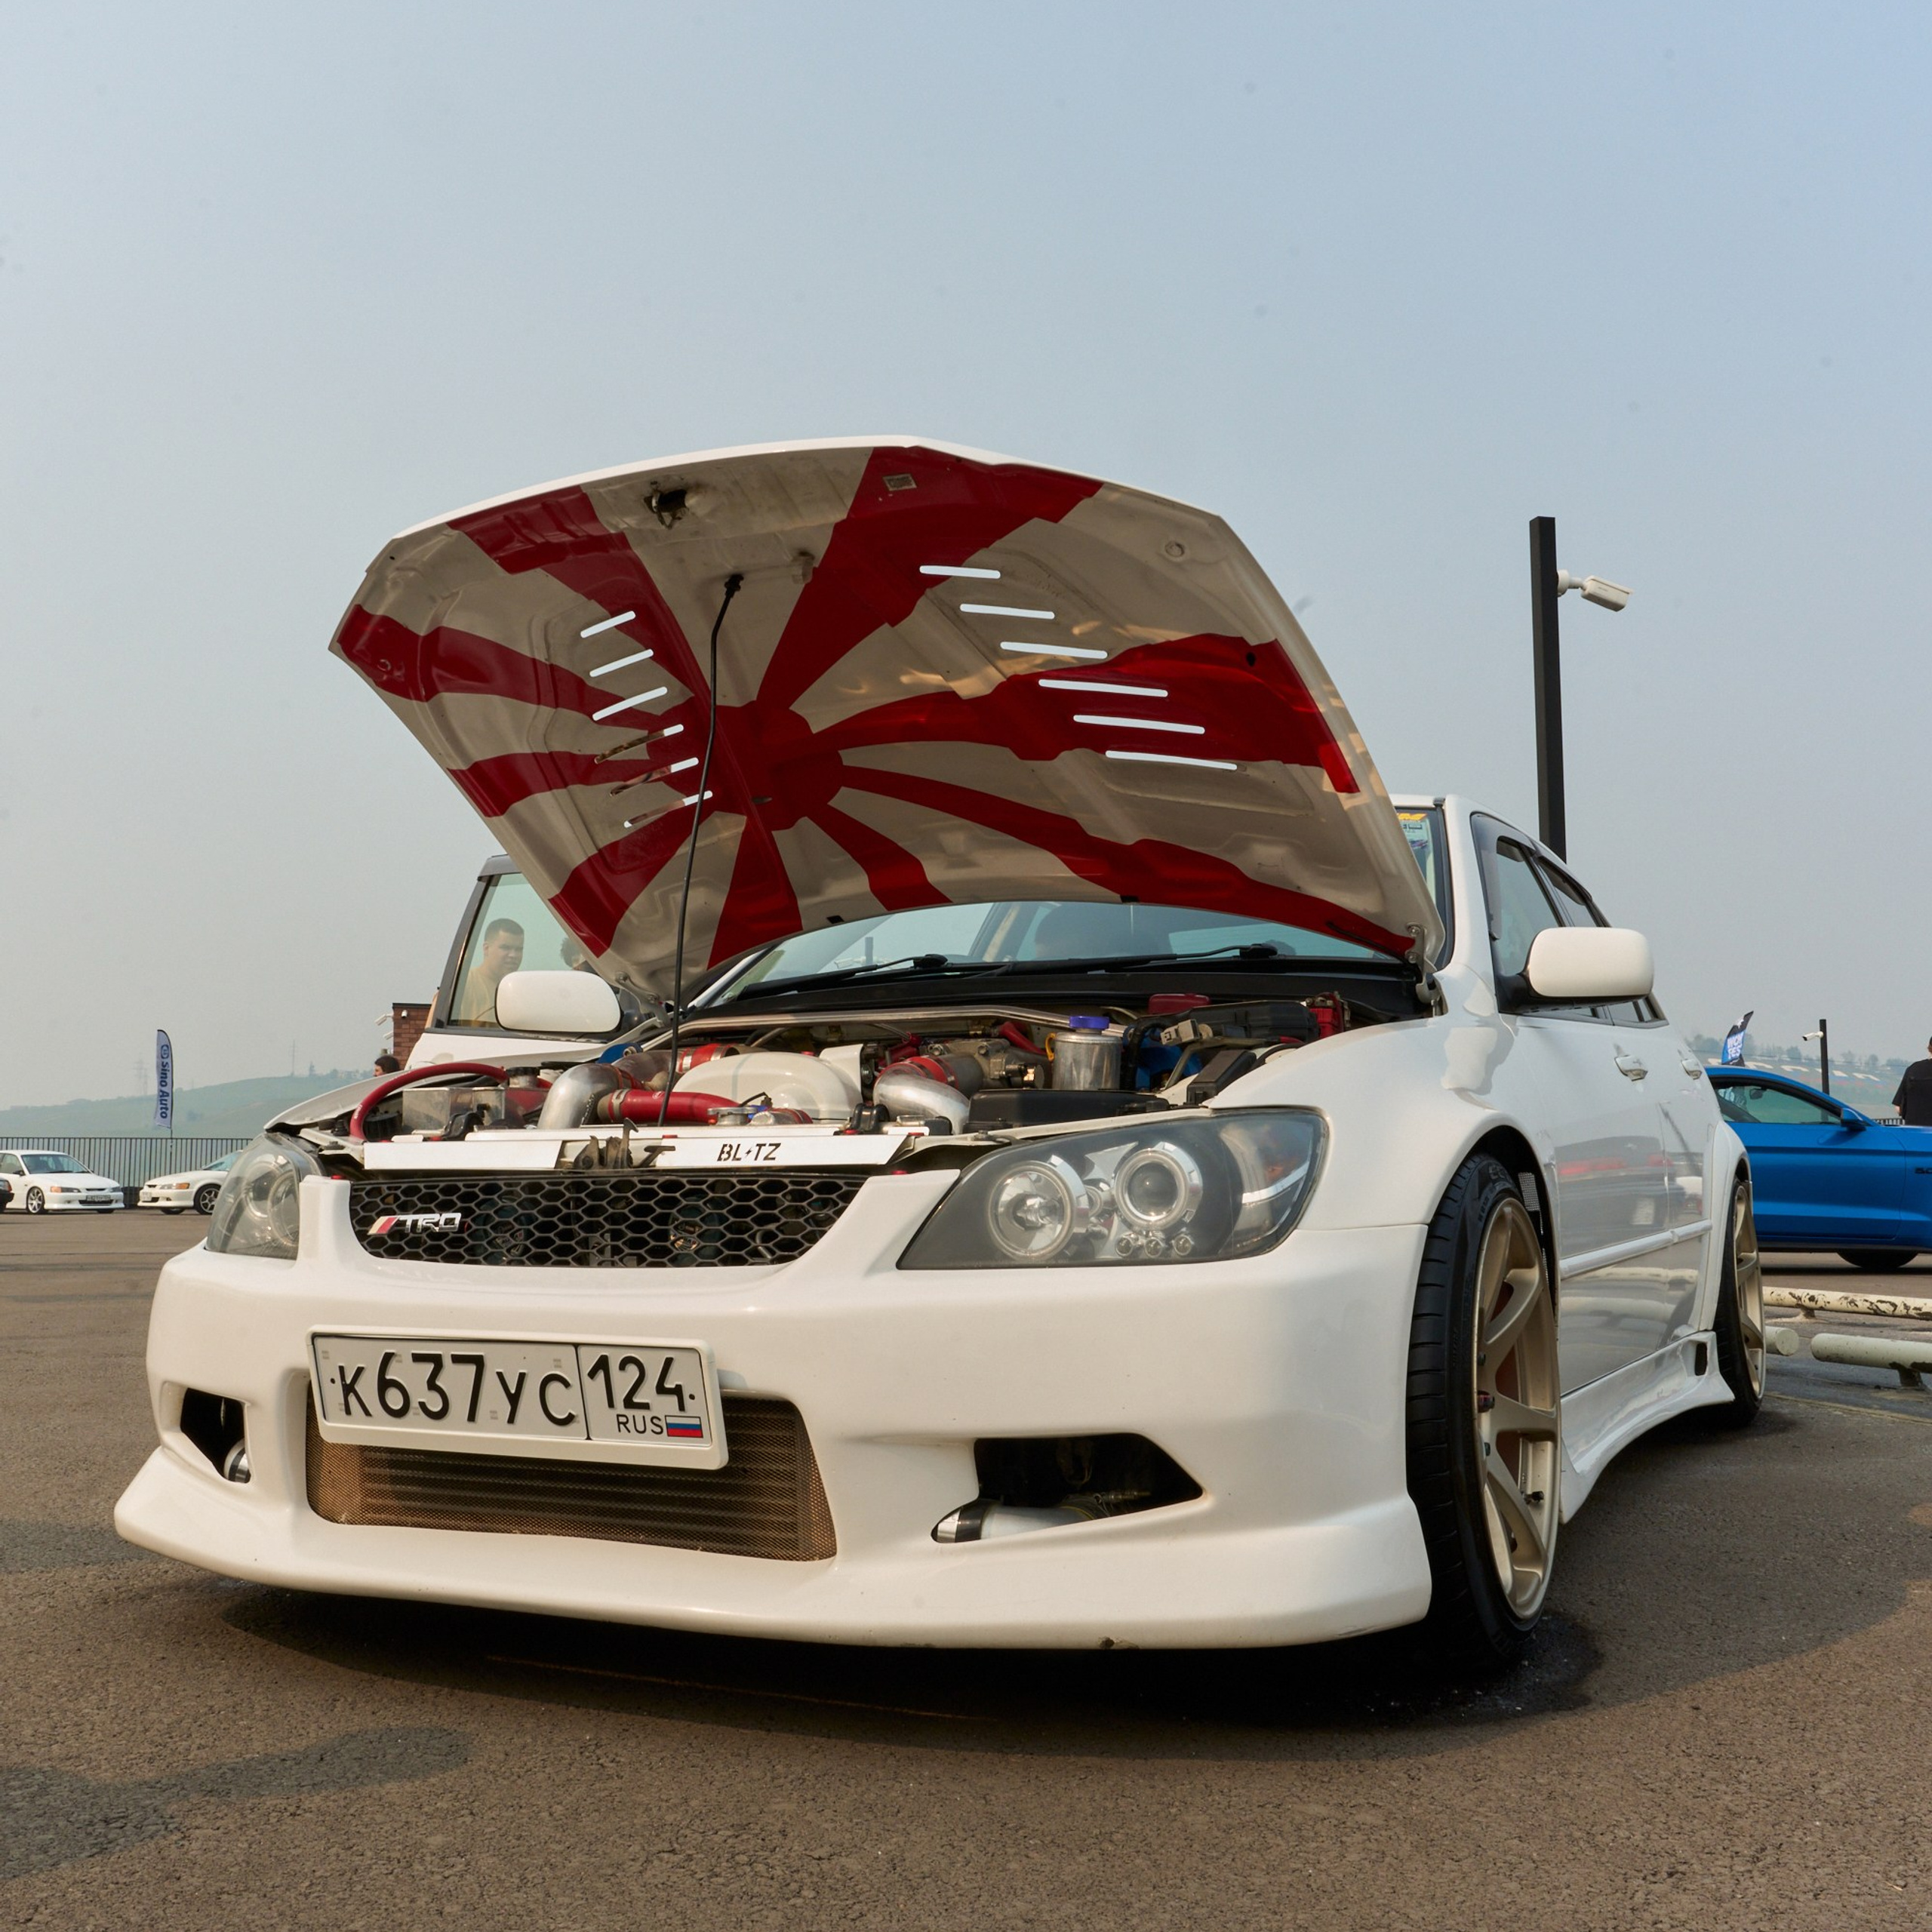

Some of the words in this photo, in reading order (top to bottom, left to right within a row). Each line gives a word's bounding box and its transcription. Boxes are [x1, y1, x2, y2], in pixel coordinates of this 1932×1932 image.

[159, 1090, 170, 1118] Auto
[398, 1213, 461, 1232] TRD
[587, 1354, 686, 1412] 124
[616, 1414, 663, 1435] RUS
